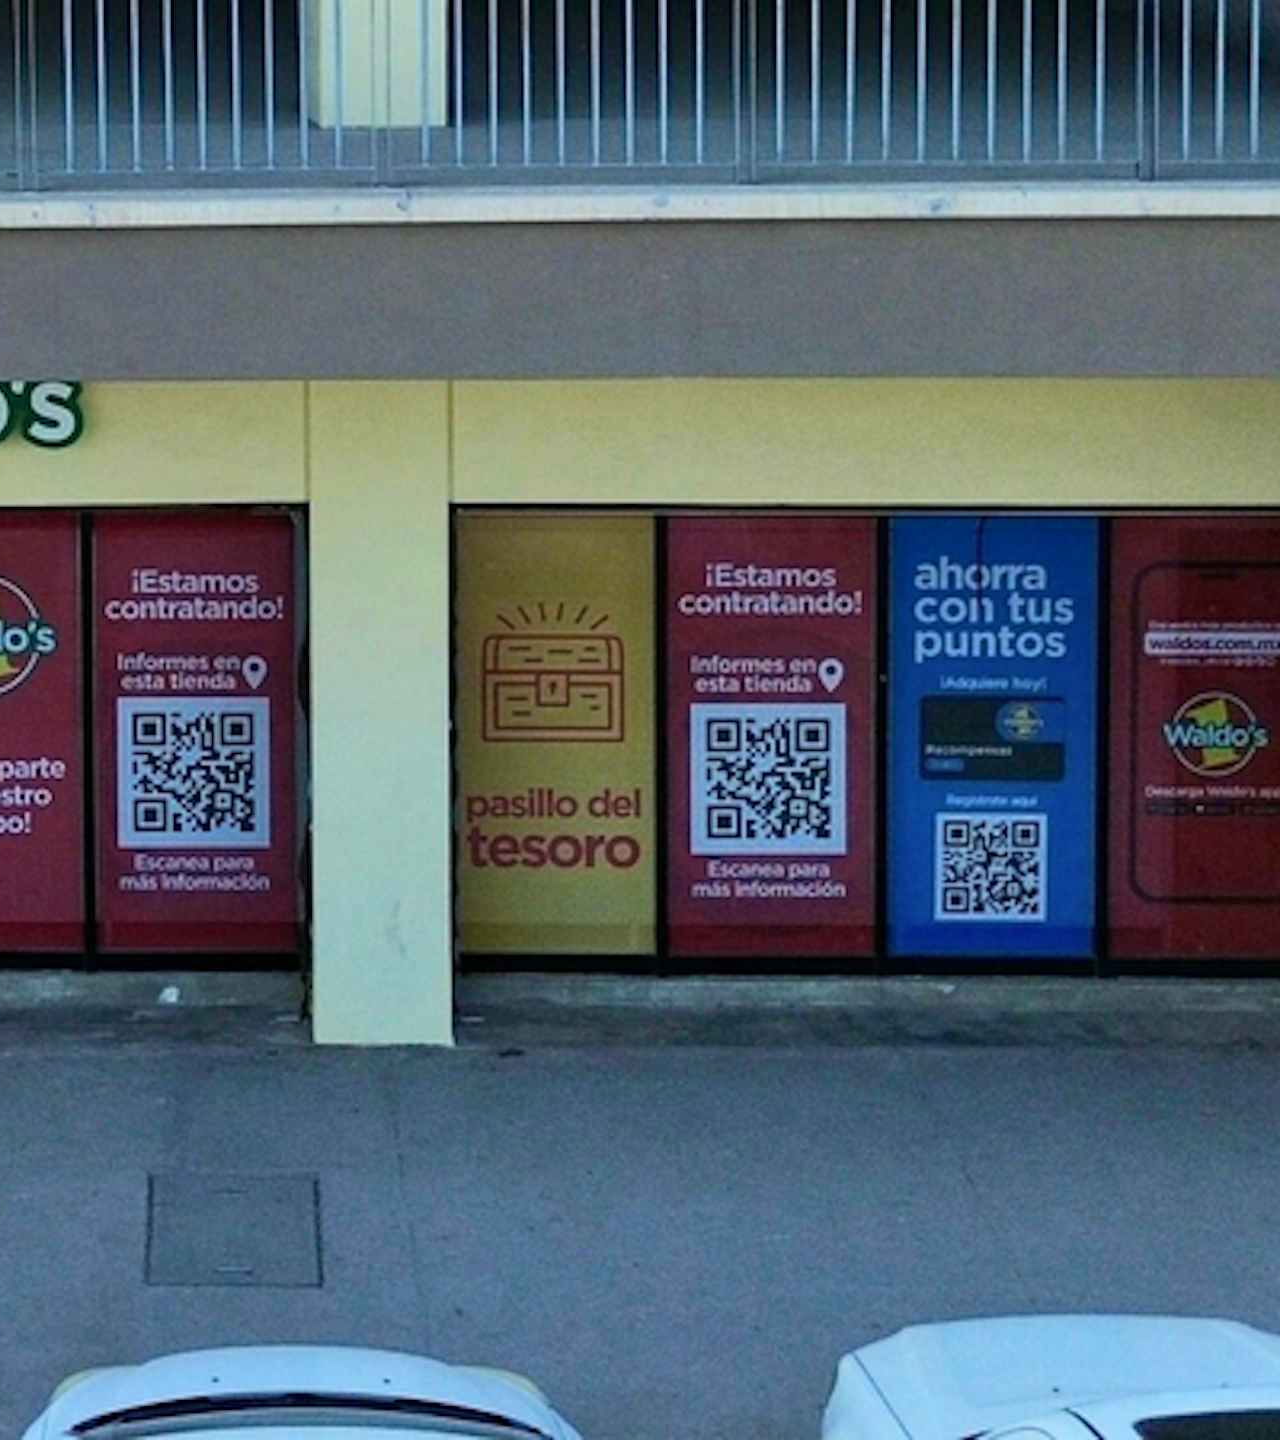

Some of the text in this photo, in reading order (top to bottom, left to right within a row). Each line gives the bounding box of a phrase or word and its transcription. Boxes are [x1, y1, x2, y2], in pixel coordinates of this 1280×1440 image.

[131, 568, 260, 593] ¡Estamos
[705, 563, 836, 587] ¡Estamos
[914, 556, 1048, 590] ahorra
[104, 596, 284, 620] contratando!
[678, 590, 863, 614] contratando!
[914, 591, 1074, 624] con tus
[914, 626, 1067, 663] puntos
[116, 652, 240, 670] Informes en
[690, 655, 817, 673] Informes en
[121, 671, 236, 689] esta tienda
[694, 675, 812, 693] esta tienda
[1163, 723, 1270, 747] Waldo's
[467, 787, 641, 822] pasillo del
[467, 826, 641, 868] tesoro
[133, 854, 254, 872] Escanea para
[707, 861, 830, 879] Escanea para
[161, 873, 270, 891] información
[734, 880, 847, 898] información
